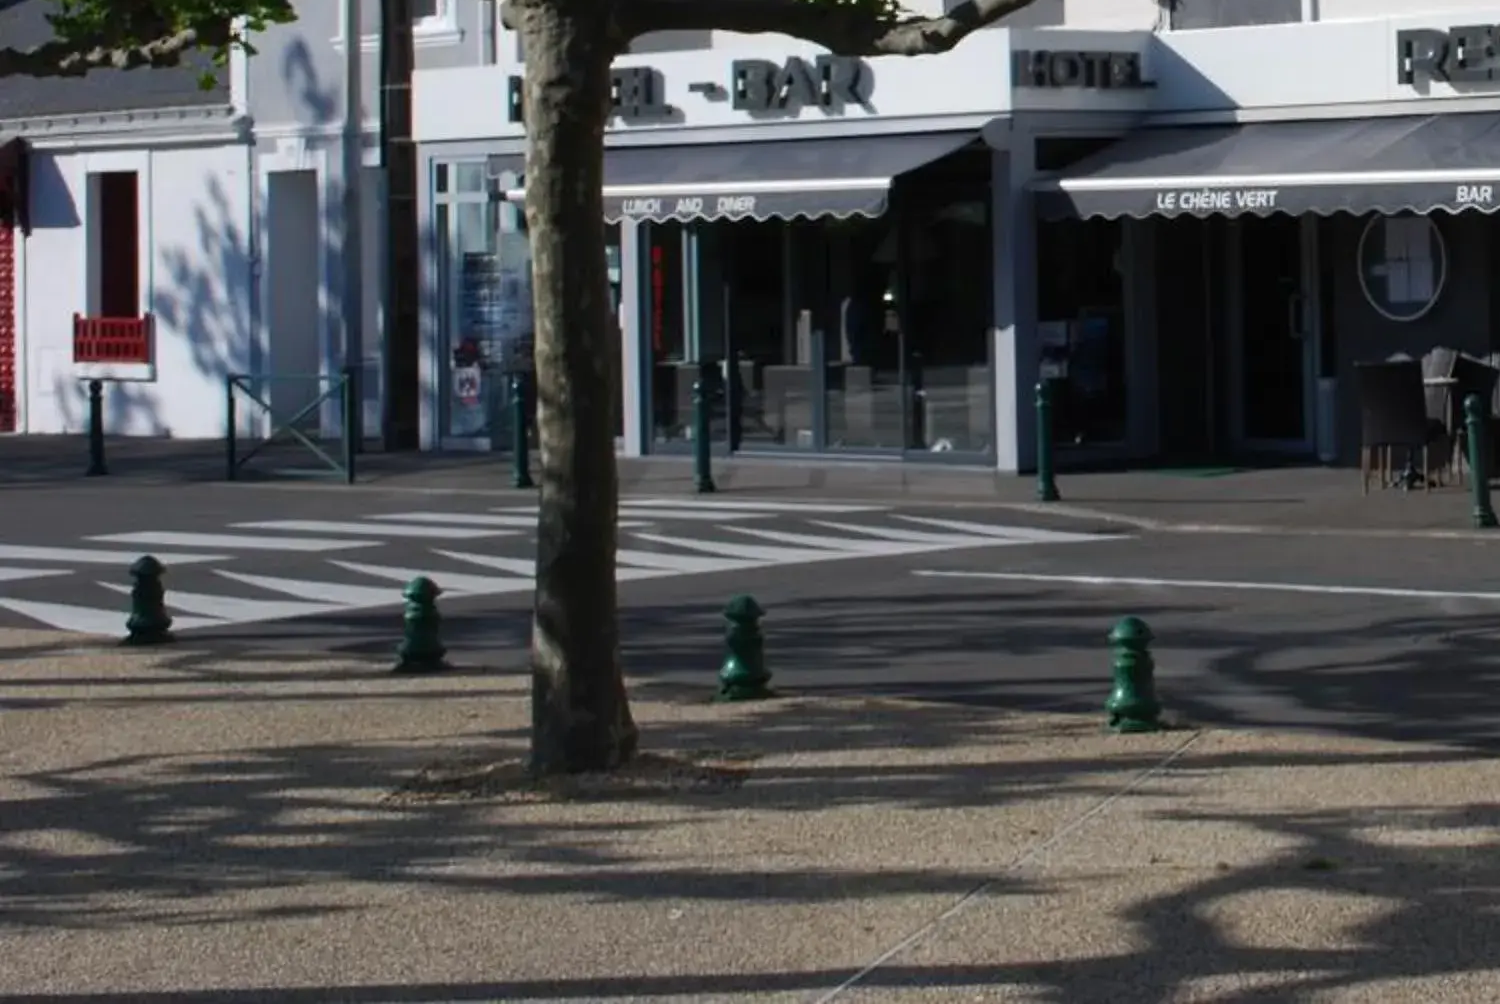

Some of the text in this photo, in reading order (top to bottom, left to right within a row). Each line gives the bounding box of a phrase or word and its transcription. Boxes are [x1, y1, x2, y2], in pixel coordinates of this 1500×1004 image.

[1010, 48, 1159, 90] HOTEL
[732, 54, 874, 112] BAR
[1157, 187, 1278, 209] LE CHÊNE VERT
[1456, 184, 1493, 203] BAR
[674, 197, 703, 213] AND
